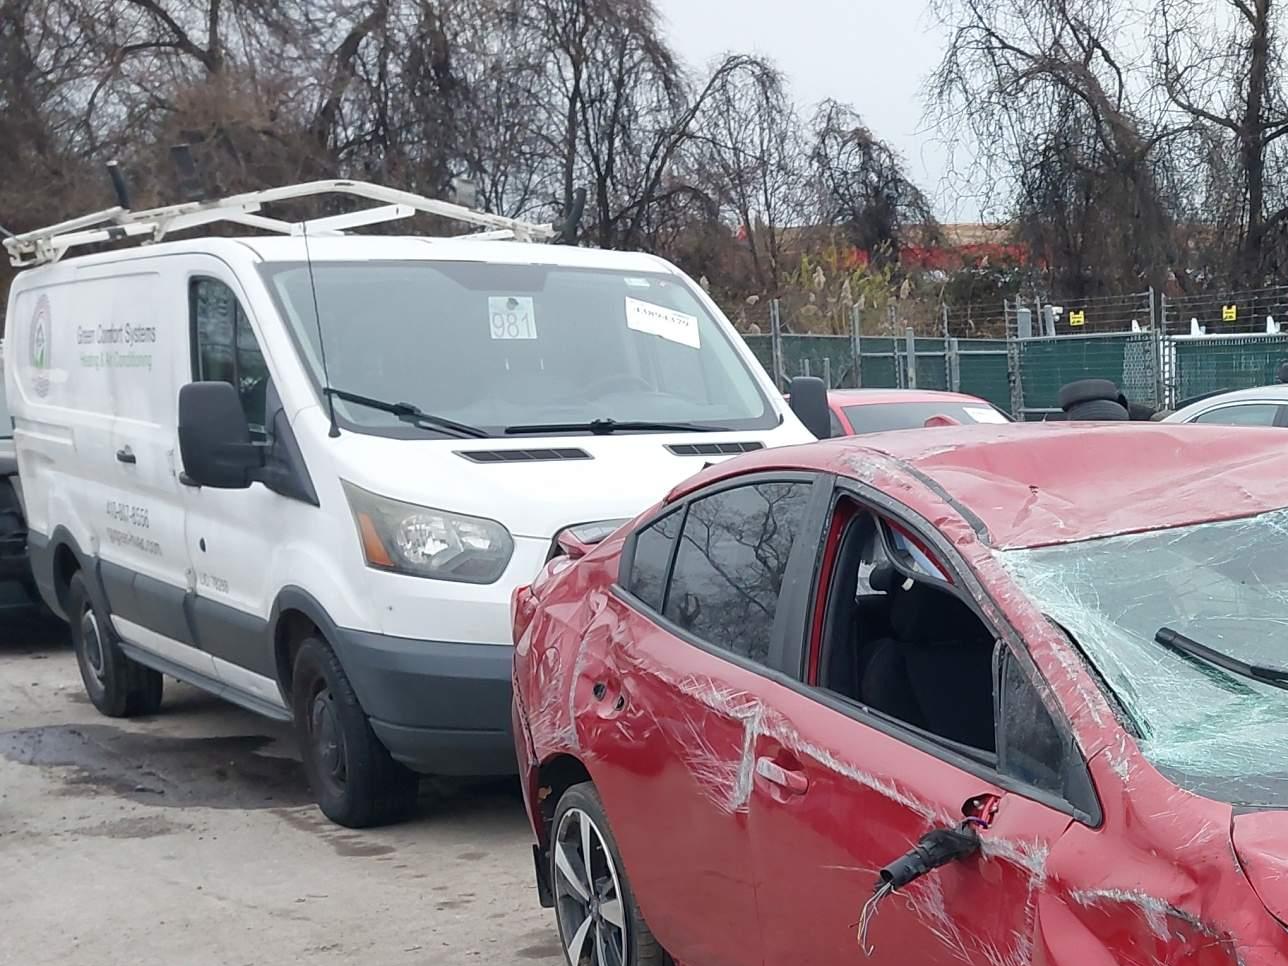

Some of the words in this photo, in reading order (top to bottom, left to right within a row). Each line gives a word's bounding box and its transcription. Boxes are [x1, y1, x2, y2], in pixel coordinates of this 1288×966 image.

[77, 325, 96, 345] Green
[97, 323, 123, 344] Comfort
[124, 322, 156, 347] Systems
[492, 312, 532, 338] 981
